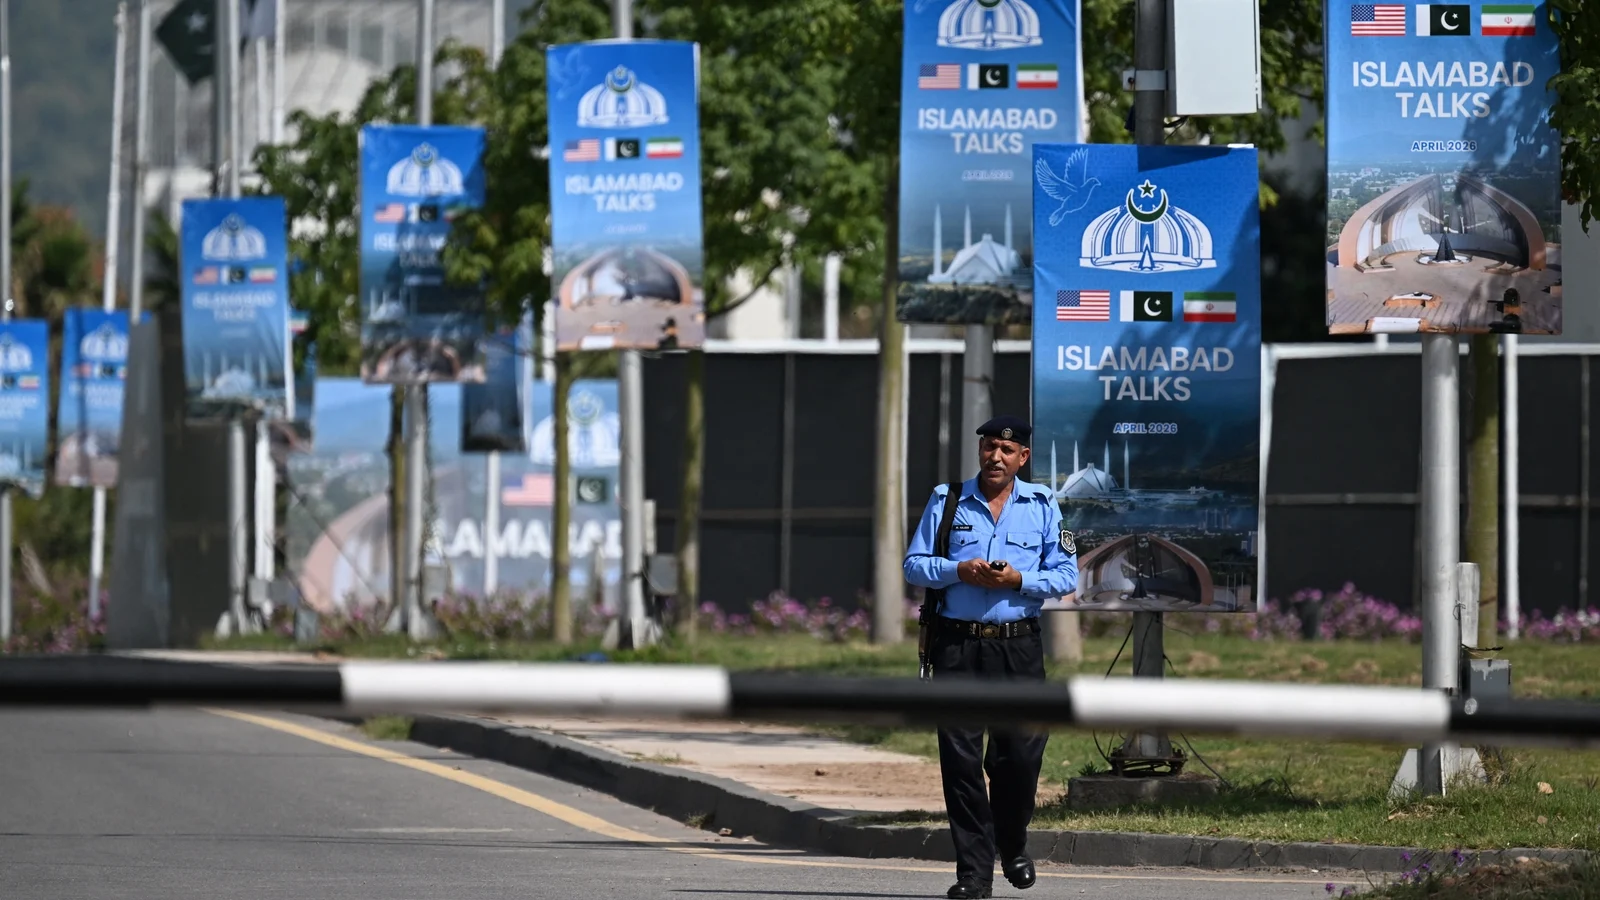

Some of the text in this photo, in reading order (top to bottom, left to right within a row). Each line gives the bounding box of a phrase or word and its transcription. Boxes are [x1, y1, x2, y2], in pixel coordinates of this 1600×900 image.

[1353, 61, 1535, 87] ISLAMABAD
[1396, 92, 1490, 118] TALKS
[918, 108, 1058, 130] ISLAMABAD
[951, 132, 1024, 154] TALKS
[1411, 140, 1477, 152] APRIL 2026
[565, 172, 684, 194] ISLAMABAD
[595, 192, 656, 212] TALKS
[1057, 345, 1234, 371] ISLAMABAD
[1099, 376, 1191, 401] TALKS
[1113, 422, 1178, 434] APRIL 2026
